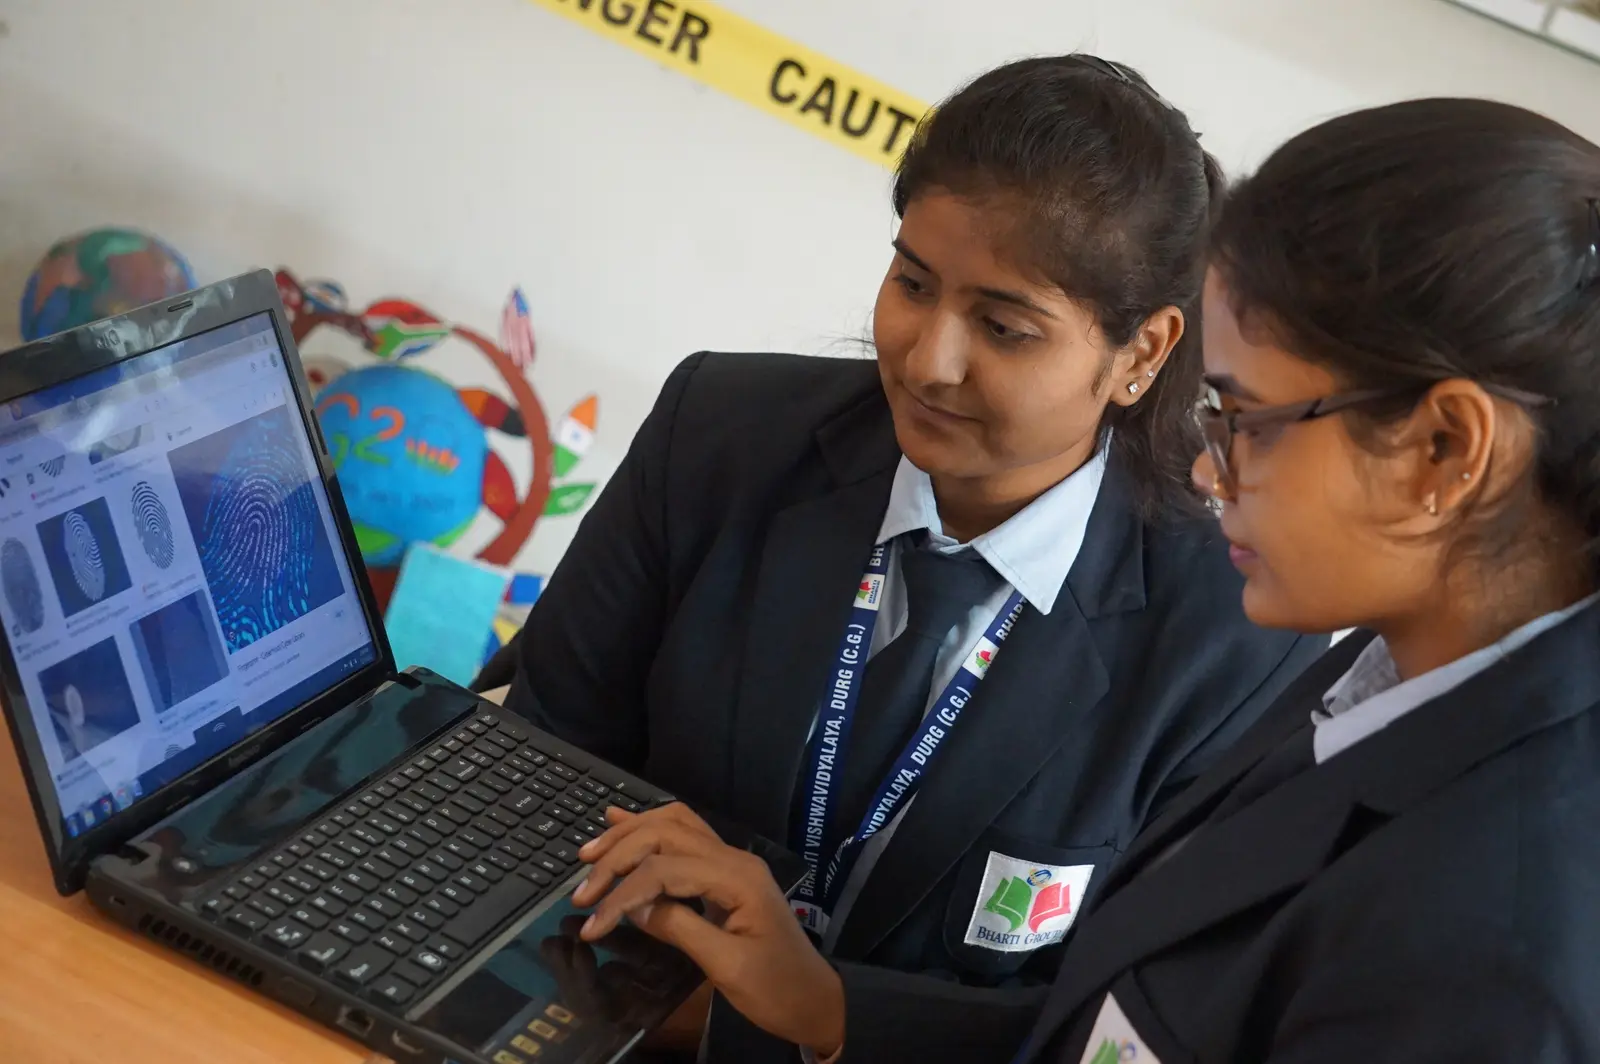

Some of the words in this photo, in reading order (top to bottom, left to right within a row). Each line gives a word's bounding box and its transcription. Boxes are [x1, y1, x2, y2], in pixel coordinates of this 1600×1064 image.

[555, 0, 710, 64] GER
[767, 57, 917, 155] CAUT
[840, 623, 866, 665] (C.G.)
[830, 668, 854, 711] DURG
[910, 725, 946, 766] DURG
[936, 685, 973, 727] (C.G.)
[805, 716, 846, 848] VISHWAVIDYALAYA,
[976, 926, 1020, 944] BHARTI
